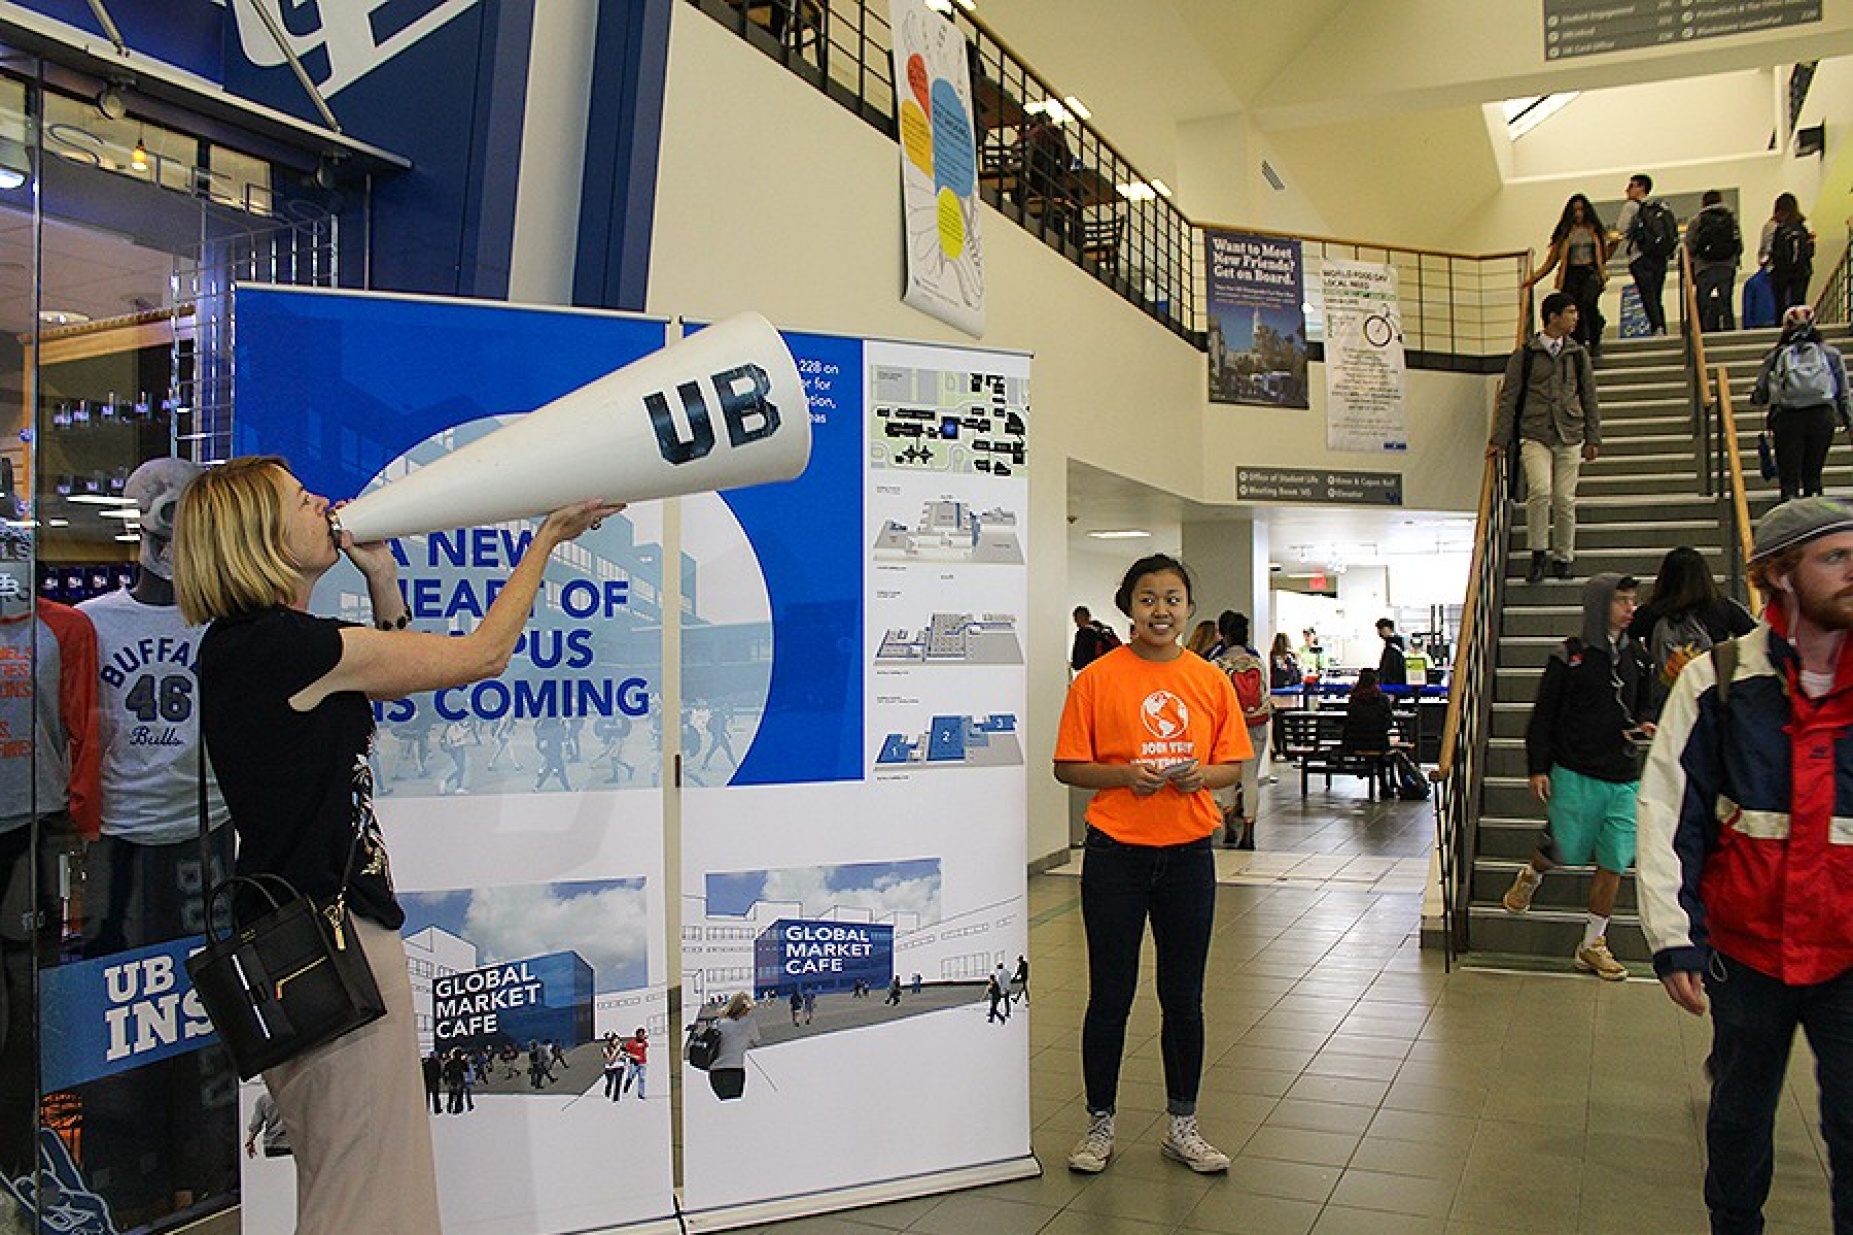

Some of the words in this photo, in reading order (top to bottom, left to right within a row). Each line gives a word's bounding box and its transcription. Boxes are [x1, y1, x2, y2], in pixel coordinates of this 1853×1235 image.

[1213, 238, 1246, 253] Want
[1247, 243, 1261, 256] to
[1262, 244, 1292, 259] Meet
[1213, 251, 1242, 266] New
[1214, 265, 1235, 279] Get
[1236, 270, 1253, 281] on
[823, 364, 839, 375] on
[815, 376, 831, 390] for
[808, 394, 837, 408] tion,
[643, 363, 781, 466] UB
[427, 528, 533, 568] NEW
[560, 579, 629, 619] OF
[101, 637, 200, 689] BUFFA
[125, 673, 193, 722] 46
[433, 677, 650, 721] COMING
[129, 725, 185, 746] Bulls
[942, 730, 950, 742] 2
[785, 925, 870, 942] GLOBAL
[785, 942, 873, 958] MARKET
[785, 958, 843, 974] CAFE
[104, 956, 176, 1003] UB
[436, 962, 536, 998] GLOBAL
[436, 983, 542, 1019] MARKET
[436, 1013, 498, 1038] CAFE
